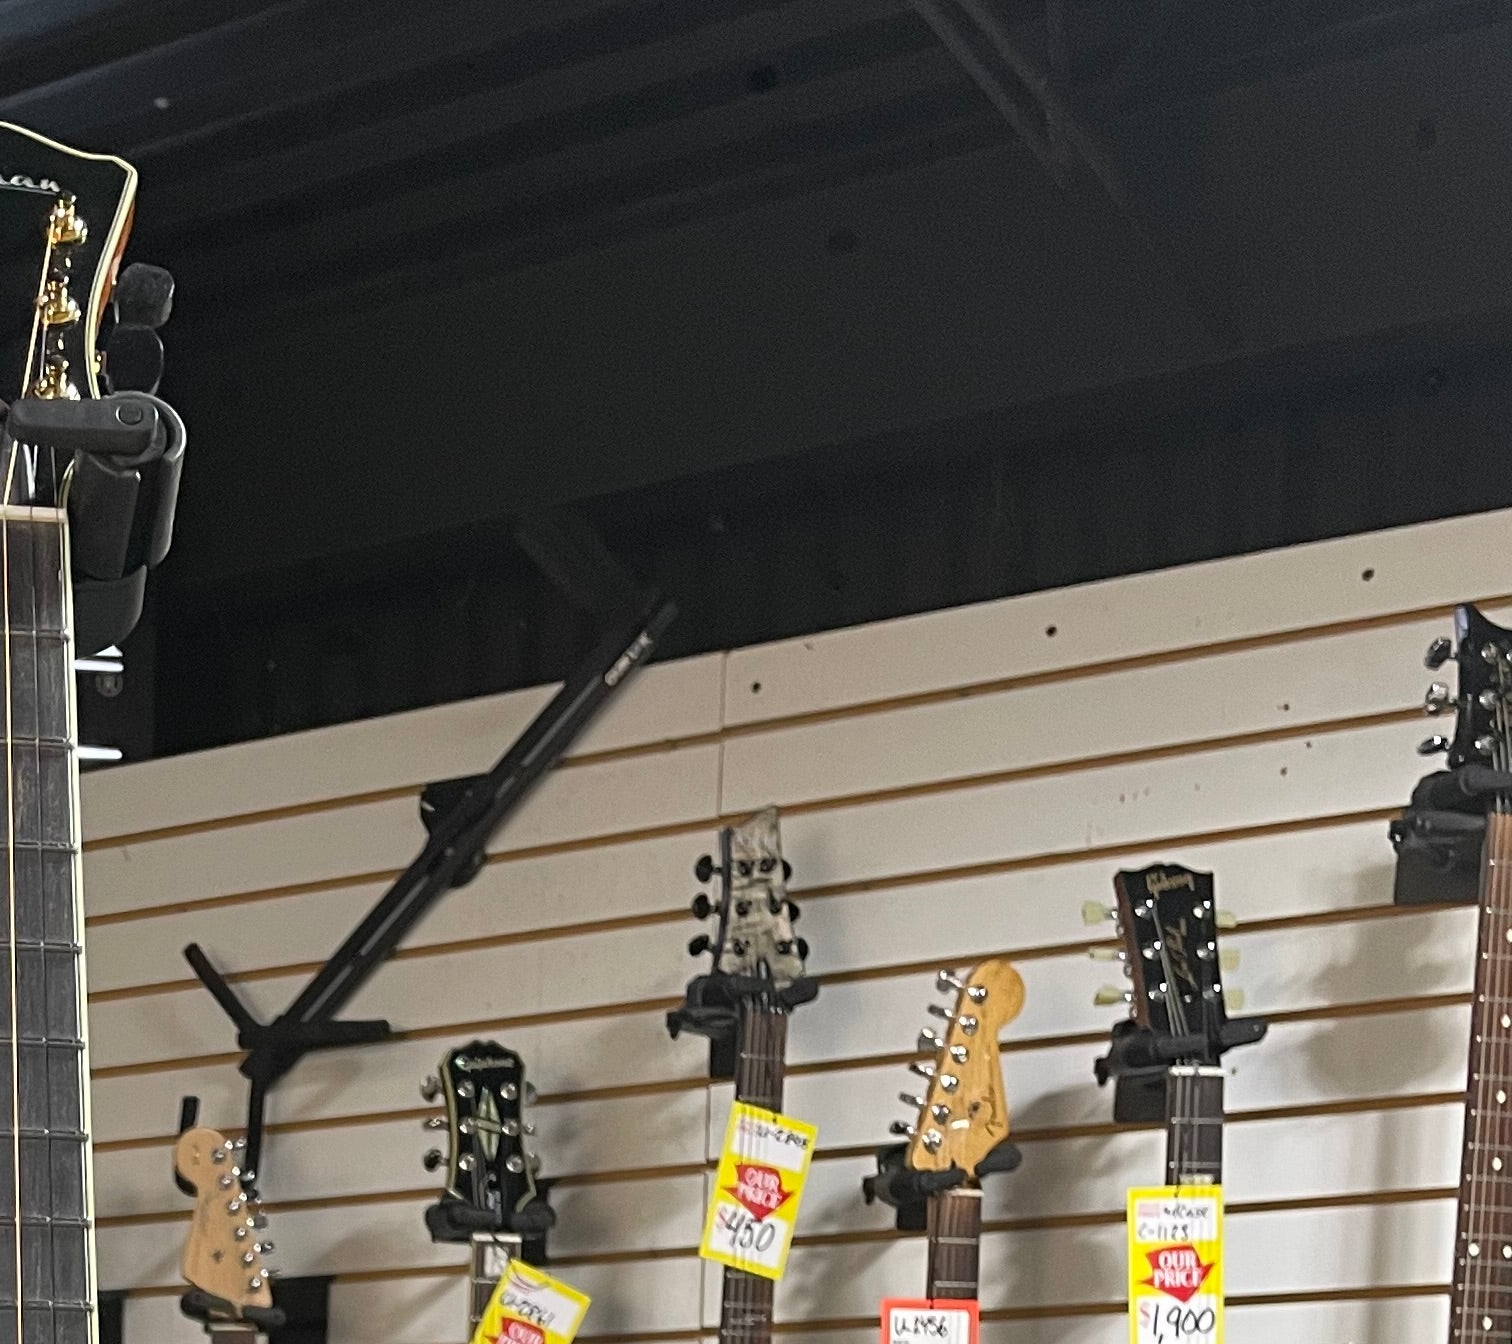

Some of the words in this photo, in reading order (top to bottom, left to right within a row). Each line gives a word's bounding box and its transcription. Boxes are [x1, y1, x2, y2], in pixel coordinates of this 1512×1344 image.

[717, 1206, 776, 1252] $450
[1158, 1250, 1196, 1270] OUR
[1153, 1266, 1204, 1289] PRICE
[1139, 1302, 1215, 1344] $1,900
